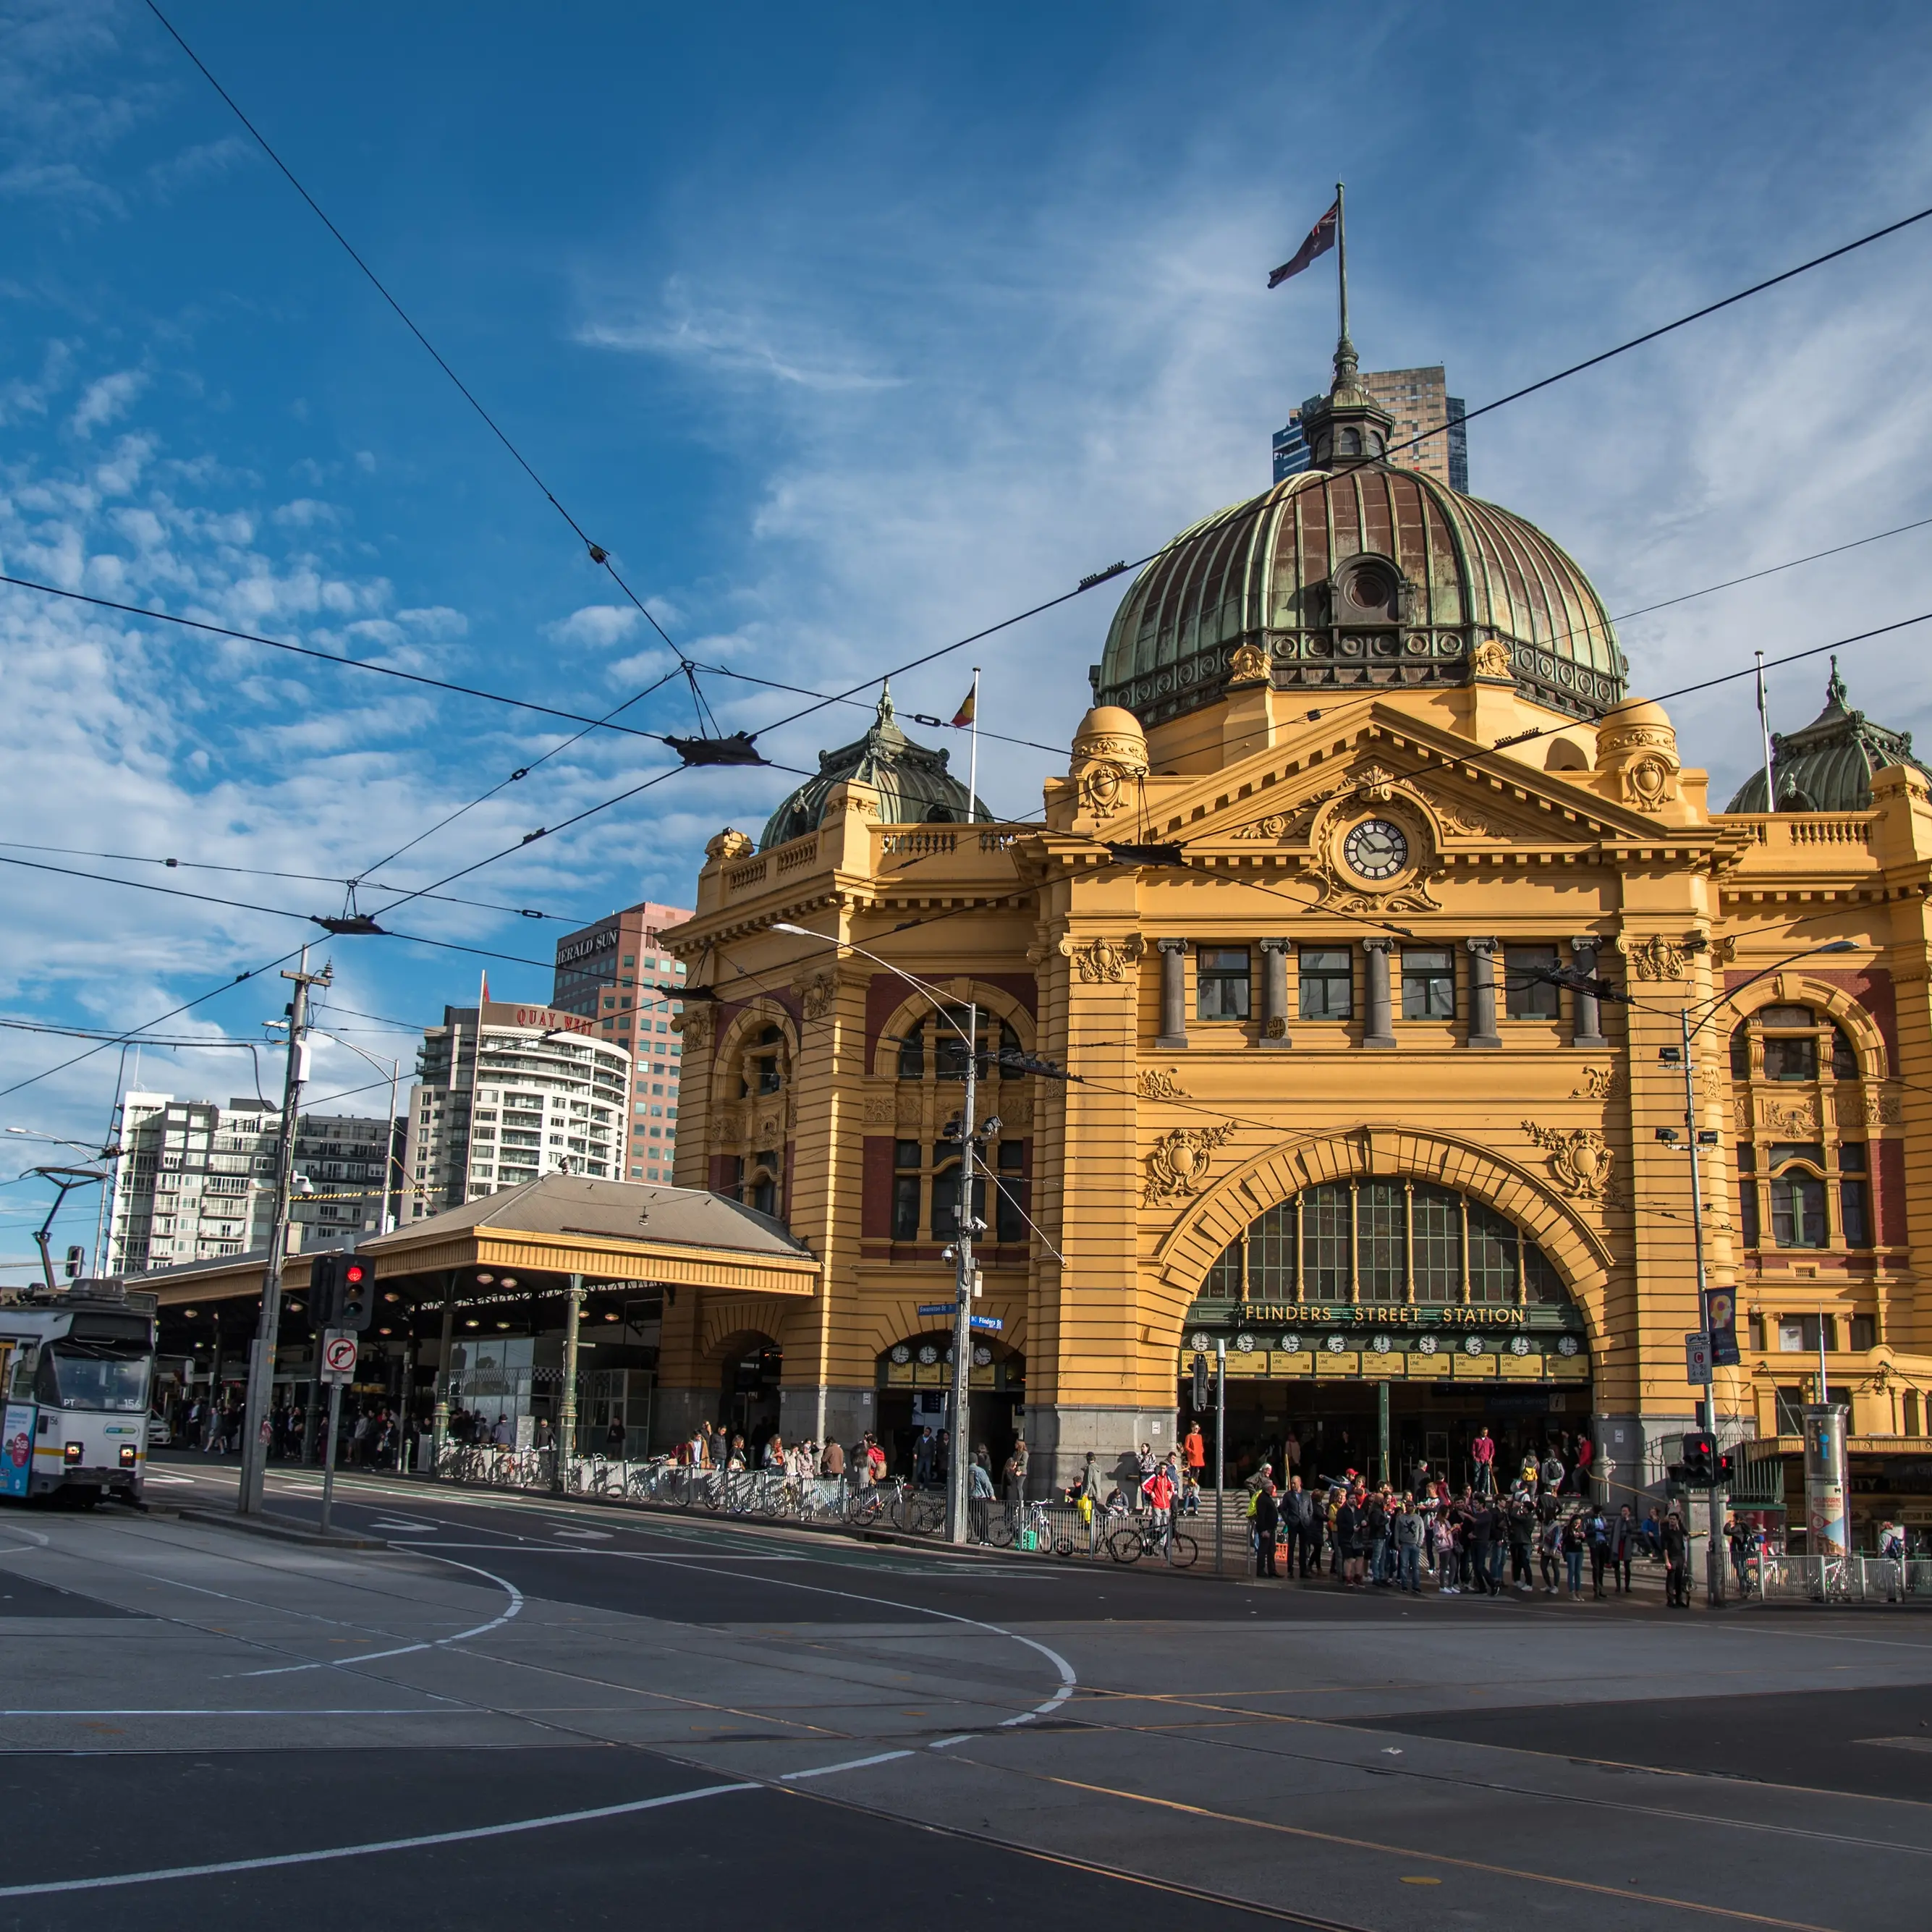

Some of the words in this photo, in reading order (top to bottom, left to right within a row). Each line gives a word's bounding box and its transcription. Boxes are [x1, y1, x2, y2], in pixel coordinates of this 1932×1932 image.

[556, 940, 593, 965] HERALD
[596, 930, 619, 949] SUN
[517, 1009, 556, 1027] QUAY
[564, 1015, 593, 1036] WEST
[1245, 1305, 1331, 1321] FLINDERS
[1355, 1307, 1420, 1322] STREET
[1443, 1308, 1524, 1323] STATION
[978, 1317, 996, 1326] Flinders
[63, 1398, 76, 1407] PT
[124, 1398, 142, 1409] 156
[49, 1416, 59, 1425] 156
[15, 1436, 29, 1449] 5GB
